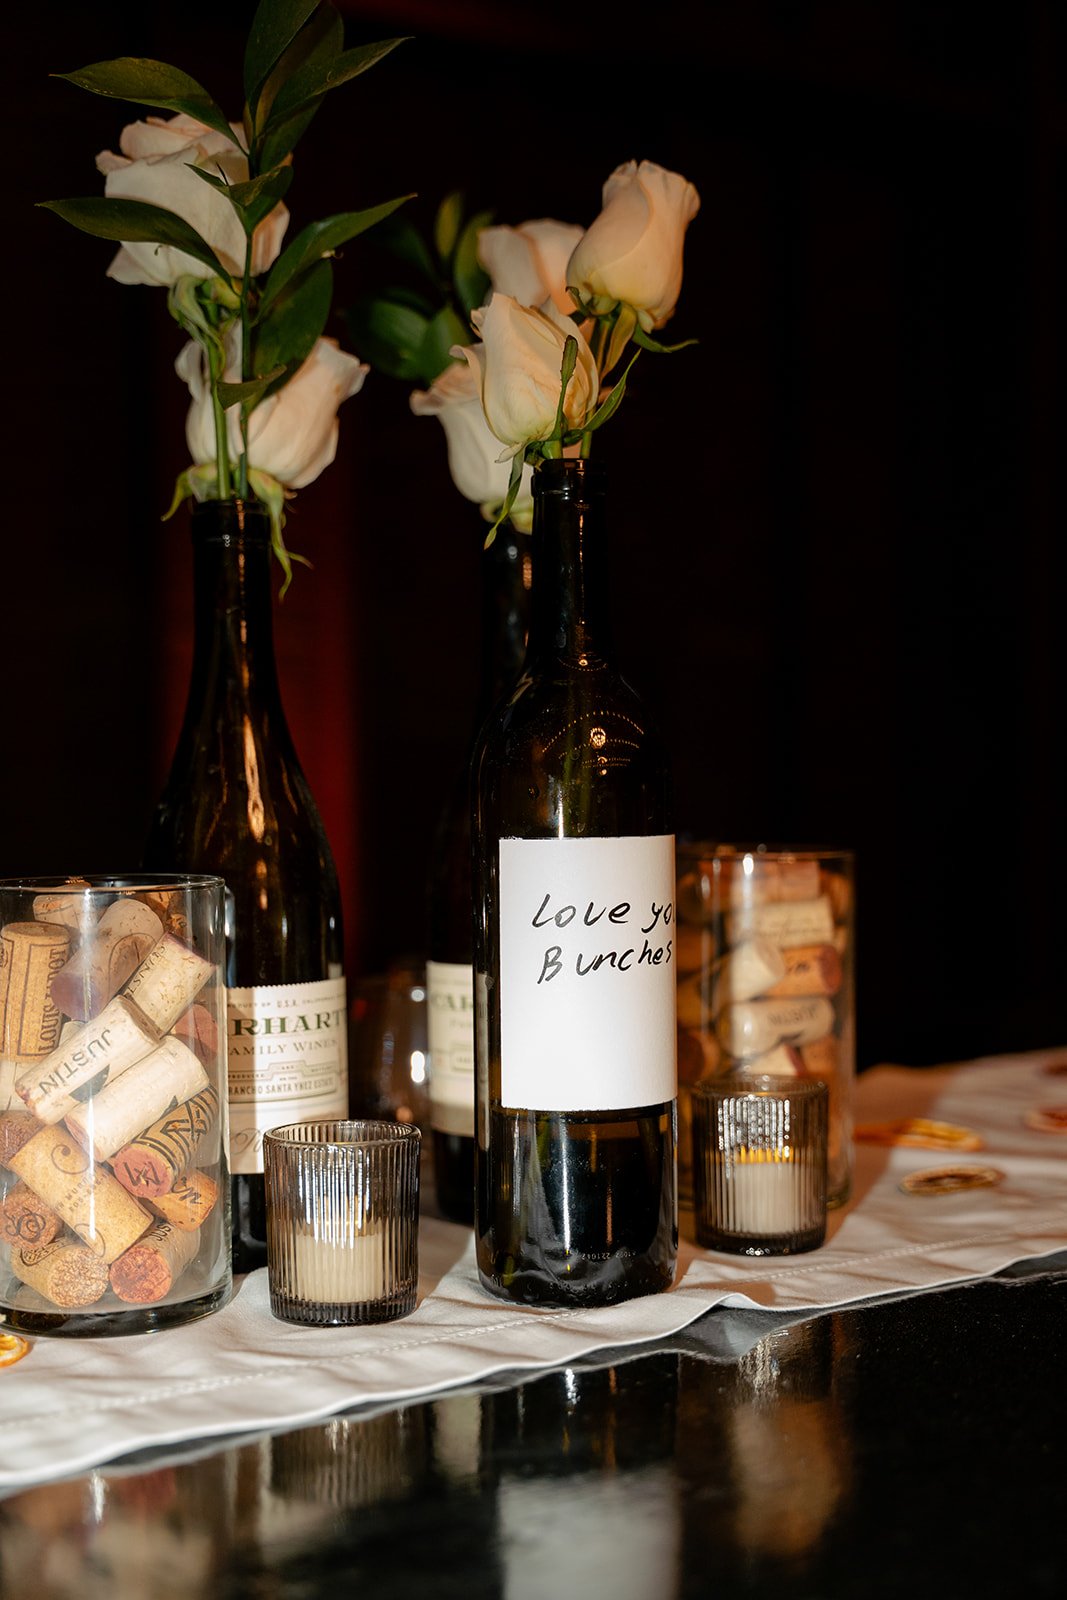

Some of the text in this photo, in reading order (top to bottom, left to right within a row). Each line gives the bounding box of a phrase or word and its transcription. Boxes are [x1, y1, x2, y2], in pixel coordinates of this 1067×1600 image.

[532, 893, 674, 933] Love yo
[537, 935, 673, 985] Bunches
[38, 1005, 60, 1052] LOUIS
[230, 1007, 346, 1036] RHART
[39, 1029, 110, 1094] JUSTIN
[228, 1044, 286, 1056] AMILY
